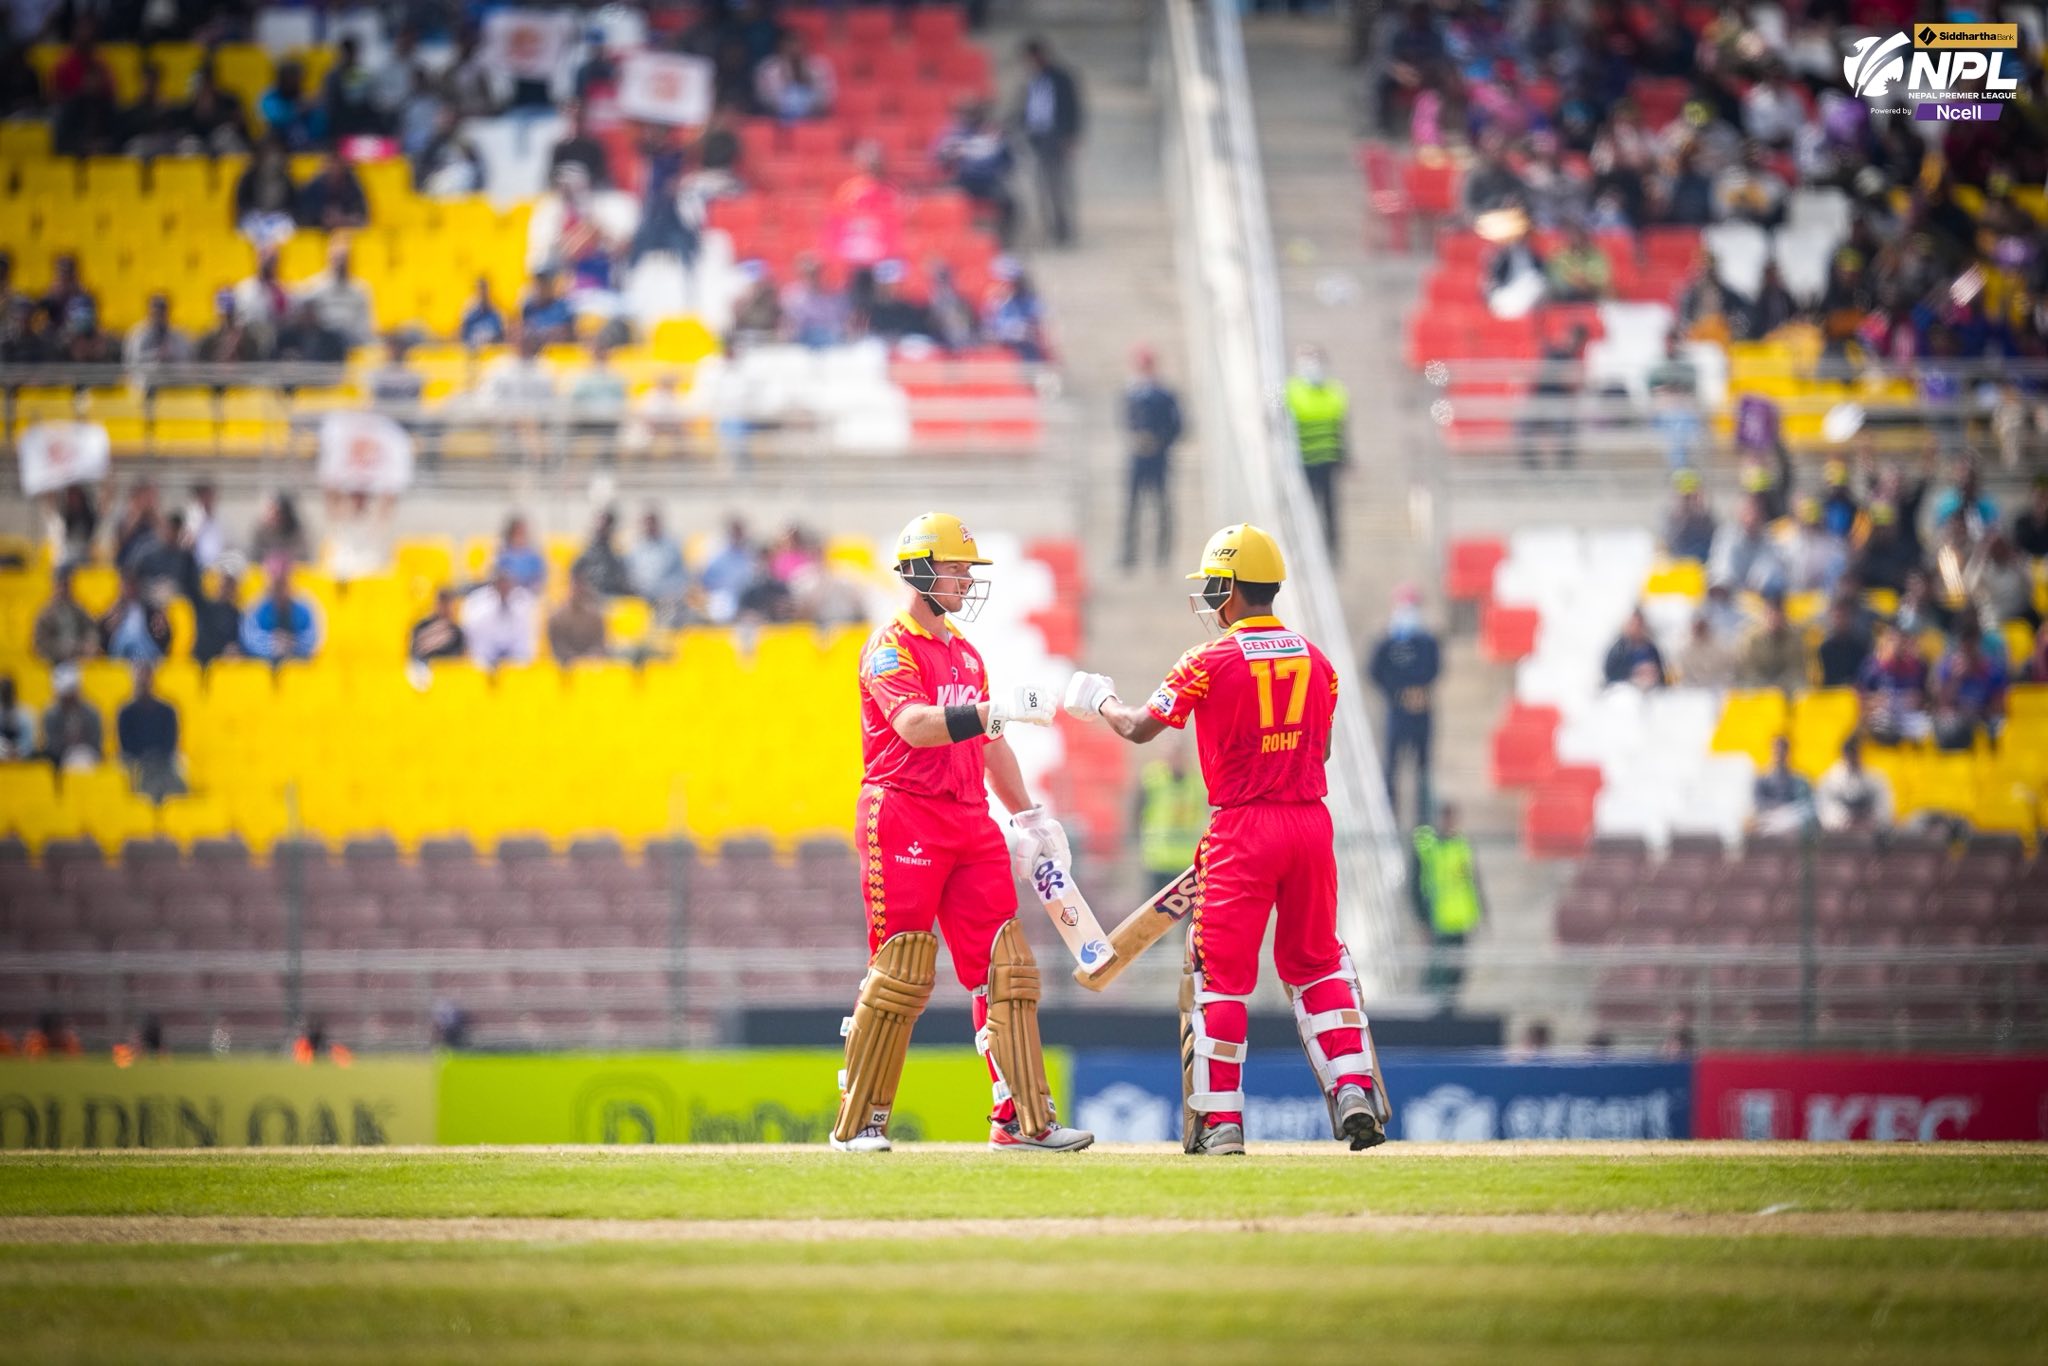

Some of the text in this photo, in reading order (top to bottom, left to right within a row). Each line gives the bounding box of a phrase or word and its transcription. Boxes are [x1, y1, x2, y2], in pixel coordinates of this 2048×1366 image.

[1243, 639, 1302, 652] CENTURY
[1028, 692, 1038, 708] DSC
[1249, 656, 1312, 729] 17
[991, 720, 1002, 735] DSC
[1034, 860, 1065, 900] DSC
[1161, 871, 1199, 916] DS
[1804, 1093, 1983, 1141] KFC
